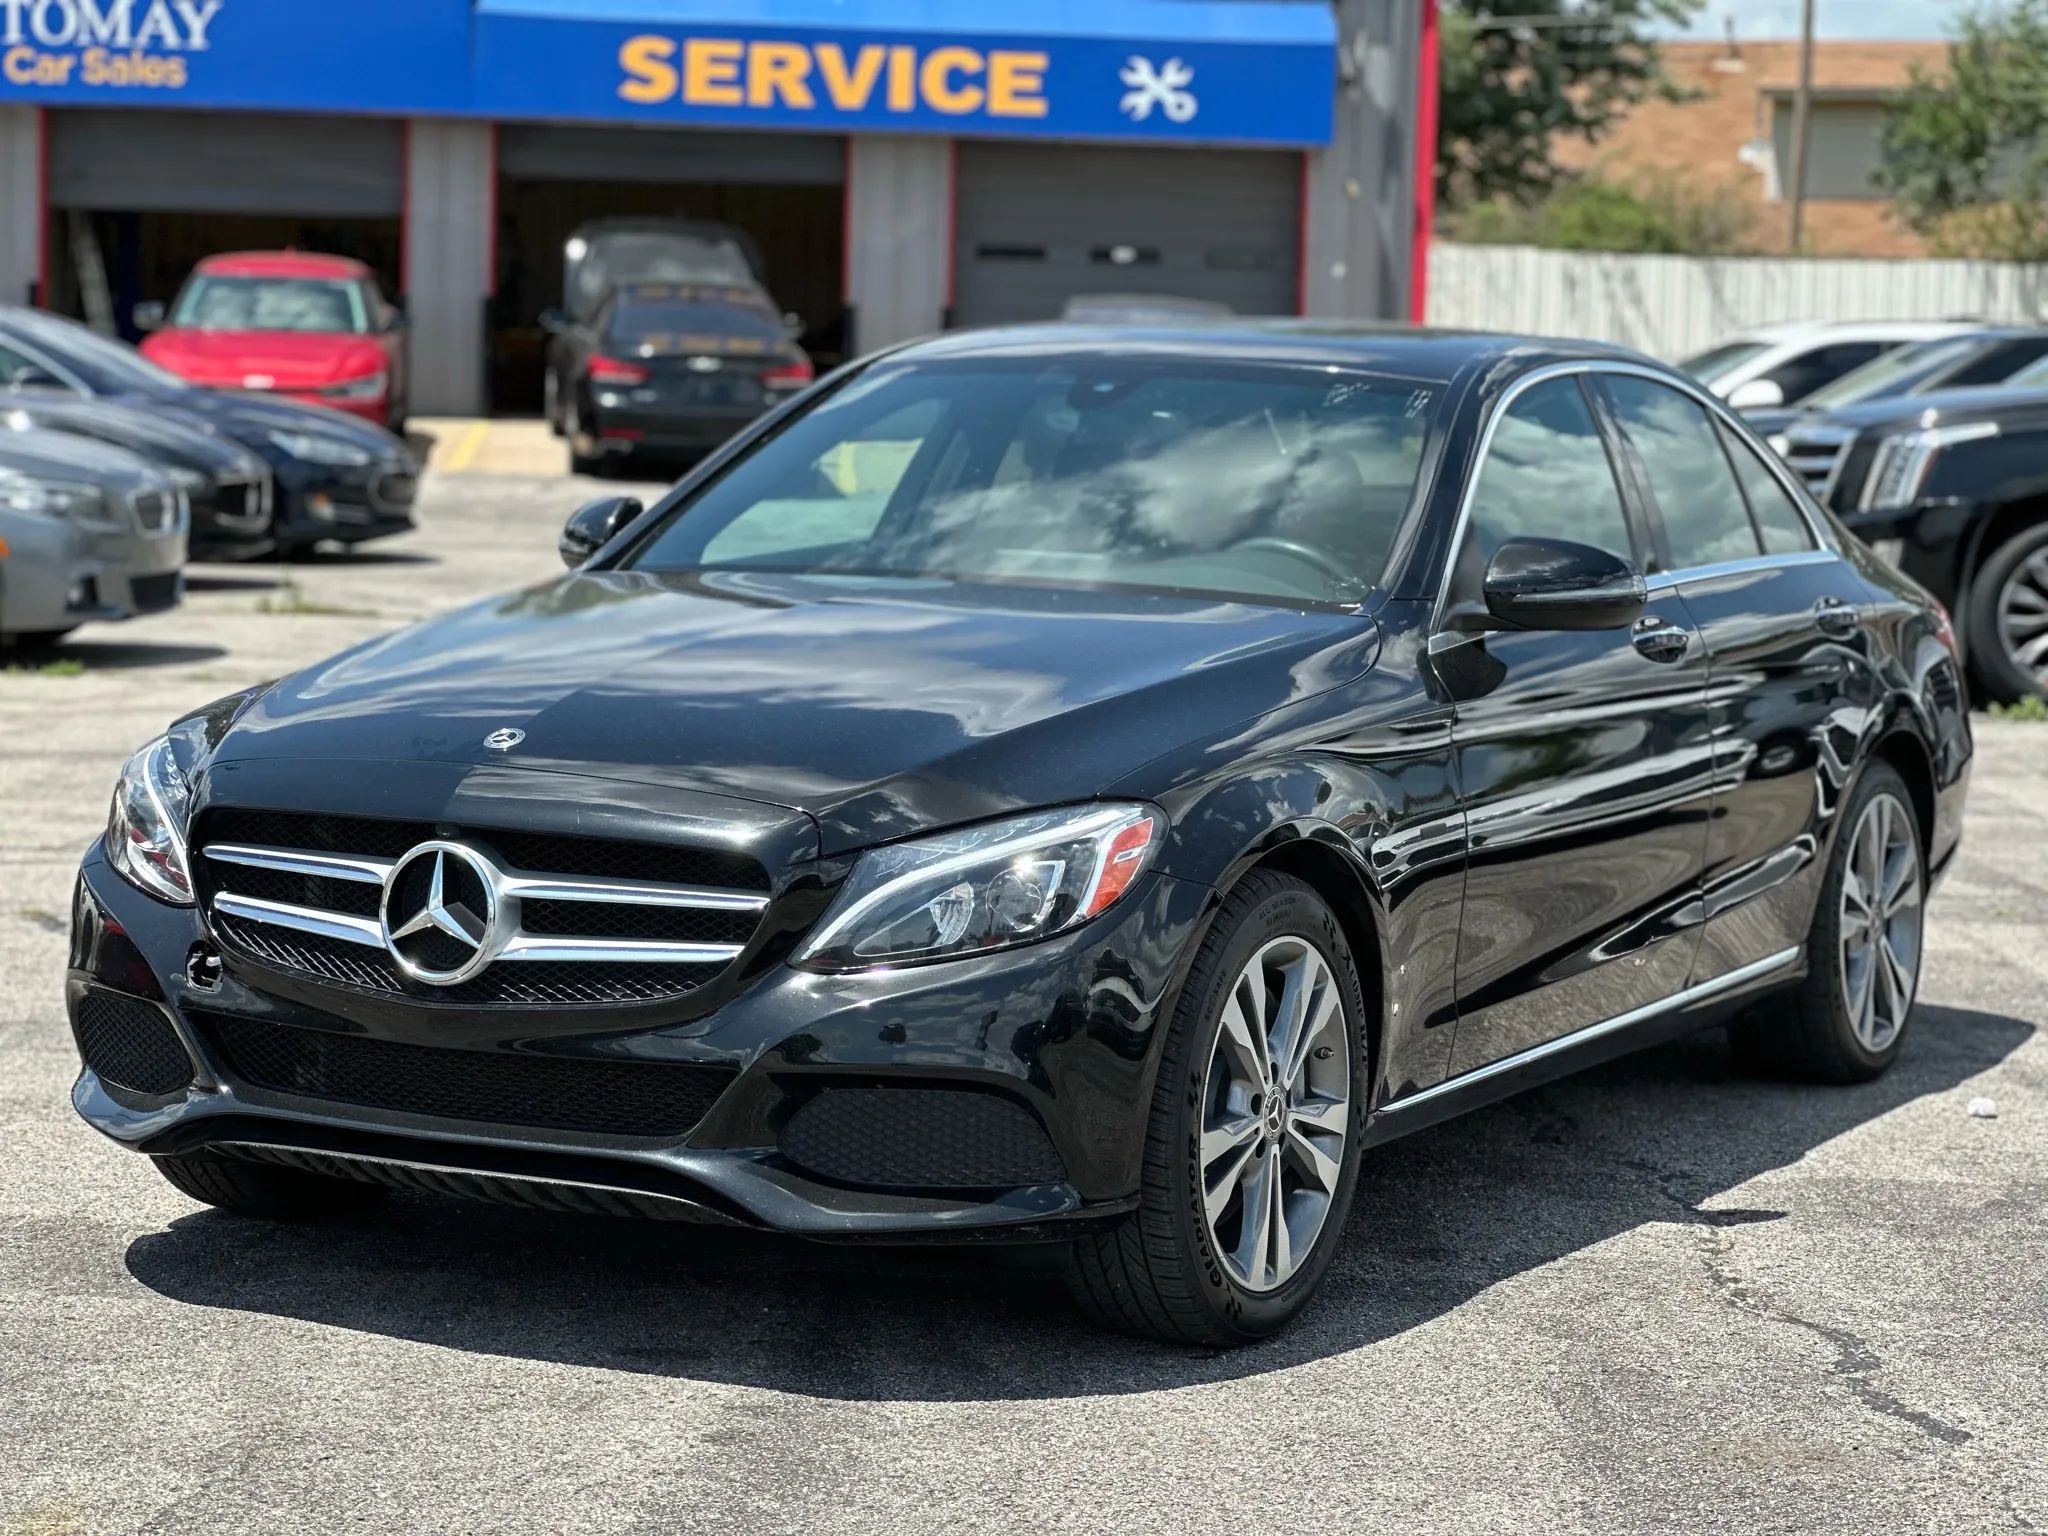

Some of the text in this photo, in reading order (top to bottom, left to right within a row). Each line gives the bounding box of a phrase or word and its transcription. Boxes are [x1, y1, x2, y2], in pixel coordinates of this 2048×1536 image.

[0, 0, 222, 50] TOMAY
[3, 46, 188, 88] Car Sales
[617, 35, 1049, 118] SERVICE
[1187, 1133, 1222, 1288] GLADIATOR
